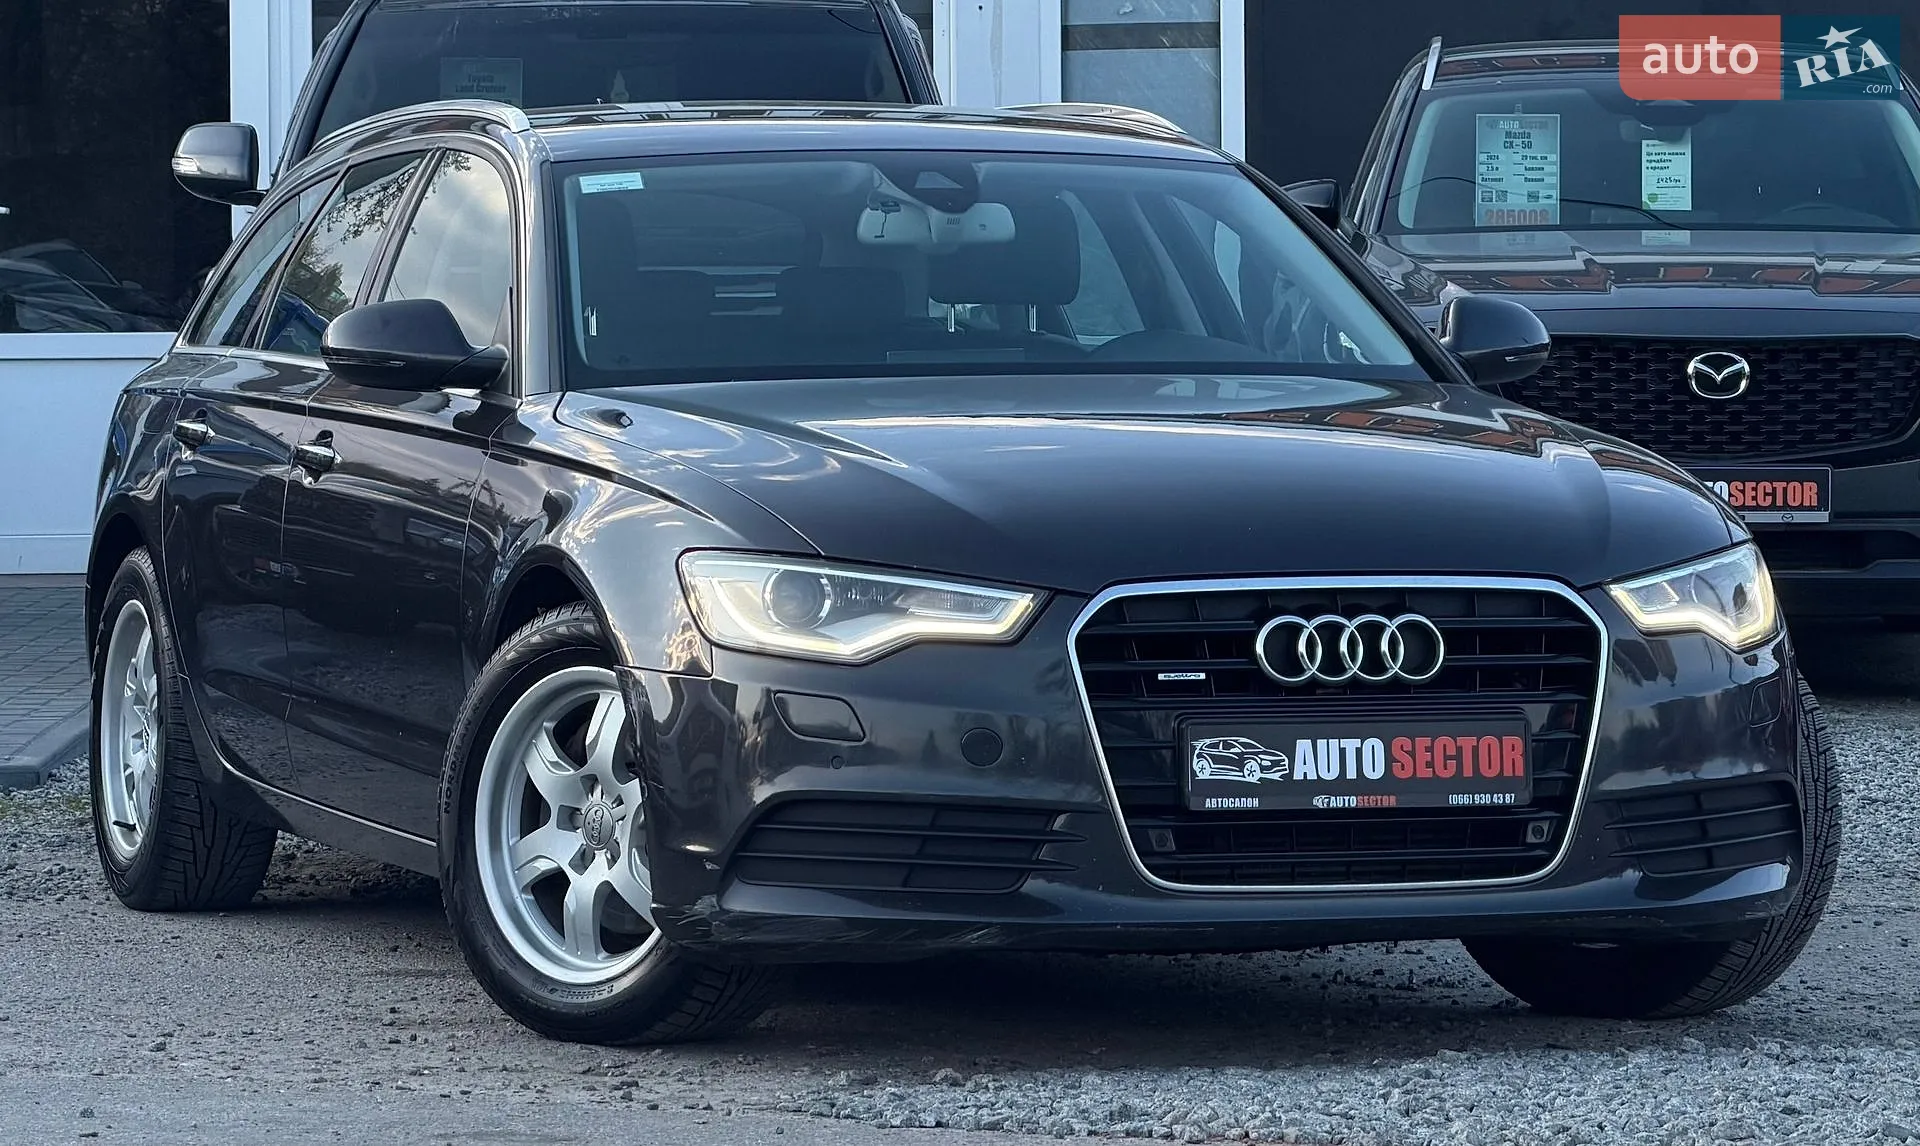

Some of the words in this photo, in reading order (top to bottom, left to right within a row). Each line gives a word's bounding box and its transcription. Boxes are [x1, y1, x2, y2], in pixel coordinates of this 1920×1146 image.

[1504, 130, 1532, 140] Mazda
[1503, 140, 1533, 150] CX-50
[1293, 737, 1386, 781] AUTO
[1391, 735, 1524, 780] SECTOR
[1205, 797, 1259, 808] АВТОСАЛОН
[1448, 793, 1473, 805] (066)
[1474, 794, 1491, 804] 930
[1492, 794, 1504, 804] 43
[1505, 793, 1515, 804] 87
